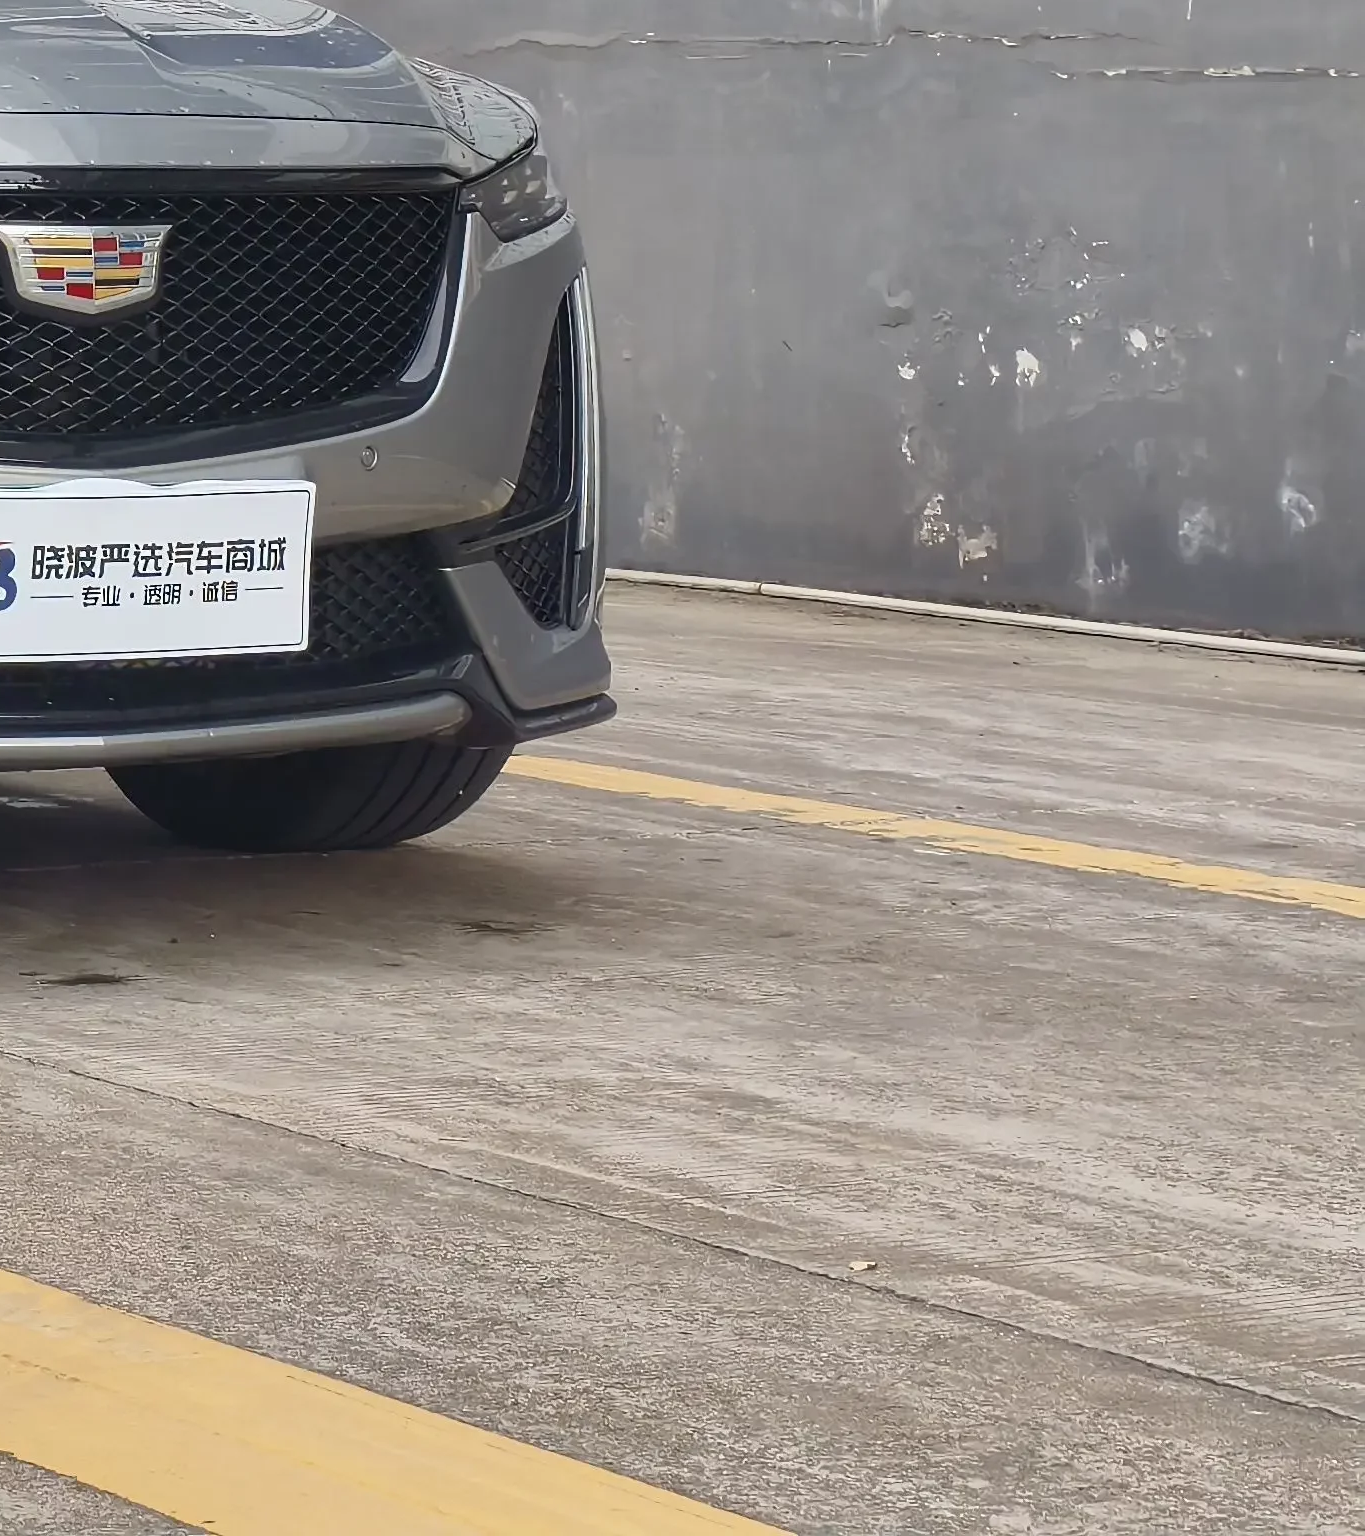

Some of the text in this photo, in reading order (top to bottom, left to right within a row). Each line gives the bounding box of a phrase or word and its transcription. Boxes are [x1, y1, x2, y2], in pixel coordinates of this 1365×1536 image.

[31, 537, 287, 581] 晓波严选汽车商城
